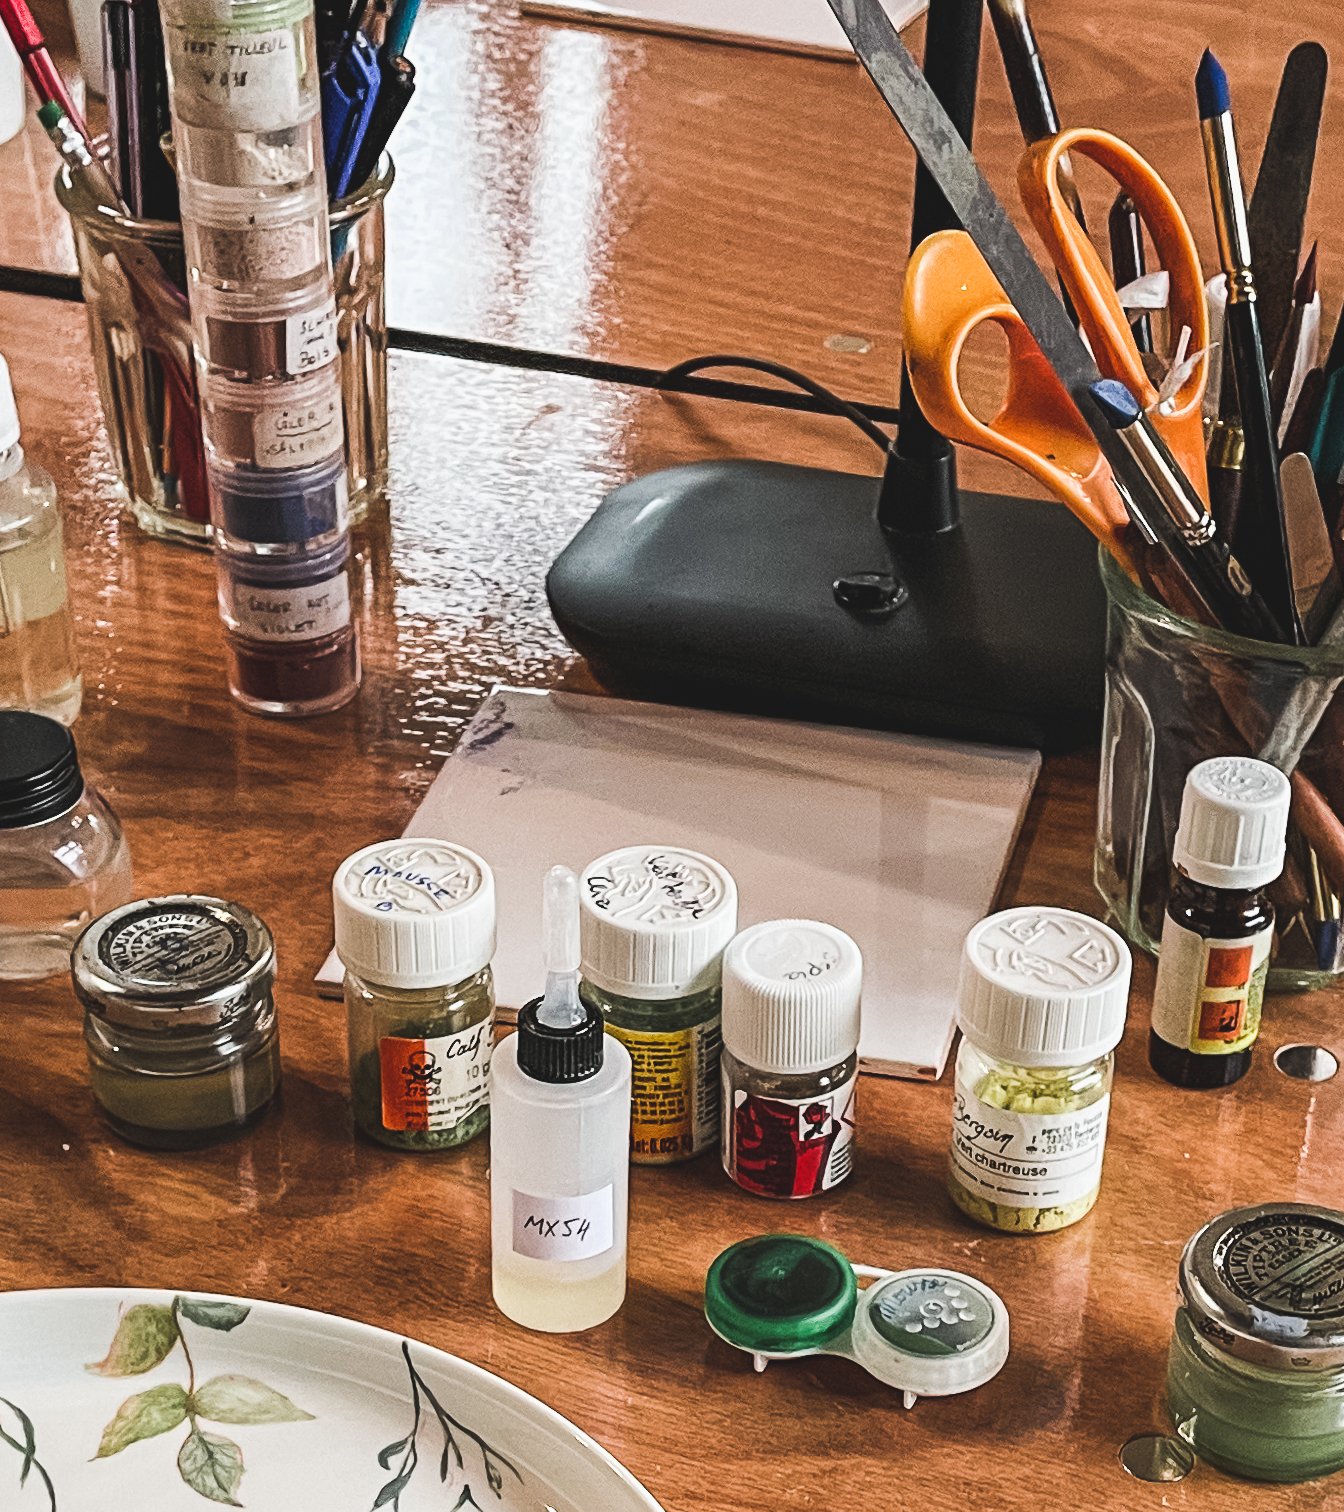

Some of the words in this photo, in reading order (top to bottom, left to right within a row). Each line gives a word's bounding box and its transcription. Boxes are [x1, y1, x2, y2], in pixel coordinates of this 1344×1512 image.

[974, 1153, 1048, 1177] chartreuse
[1230, 1241, 1261, 1295] WILKIN
[1260, 1226, 1314, 1241] SONS
[1253, 1238, 1318, 1281] TIPTREE
